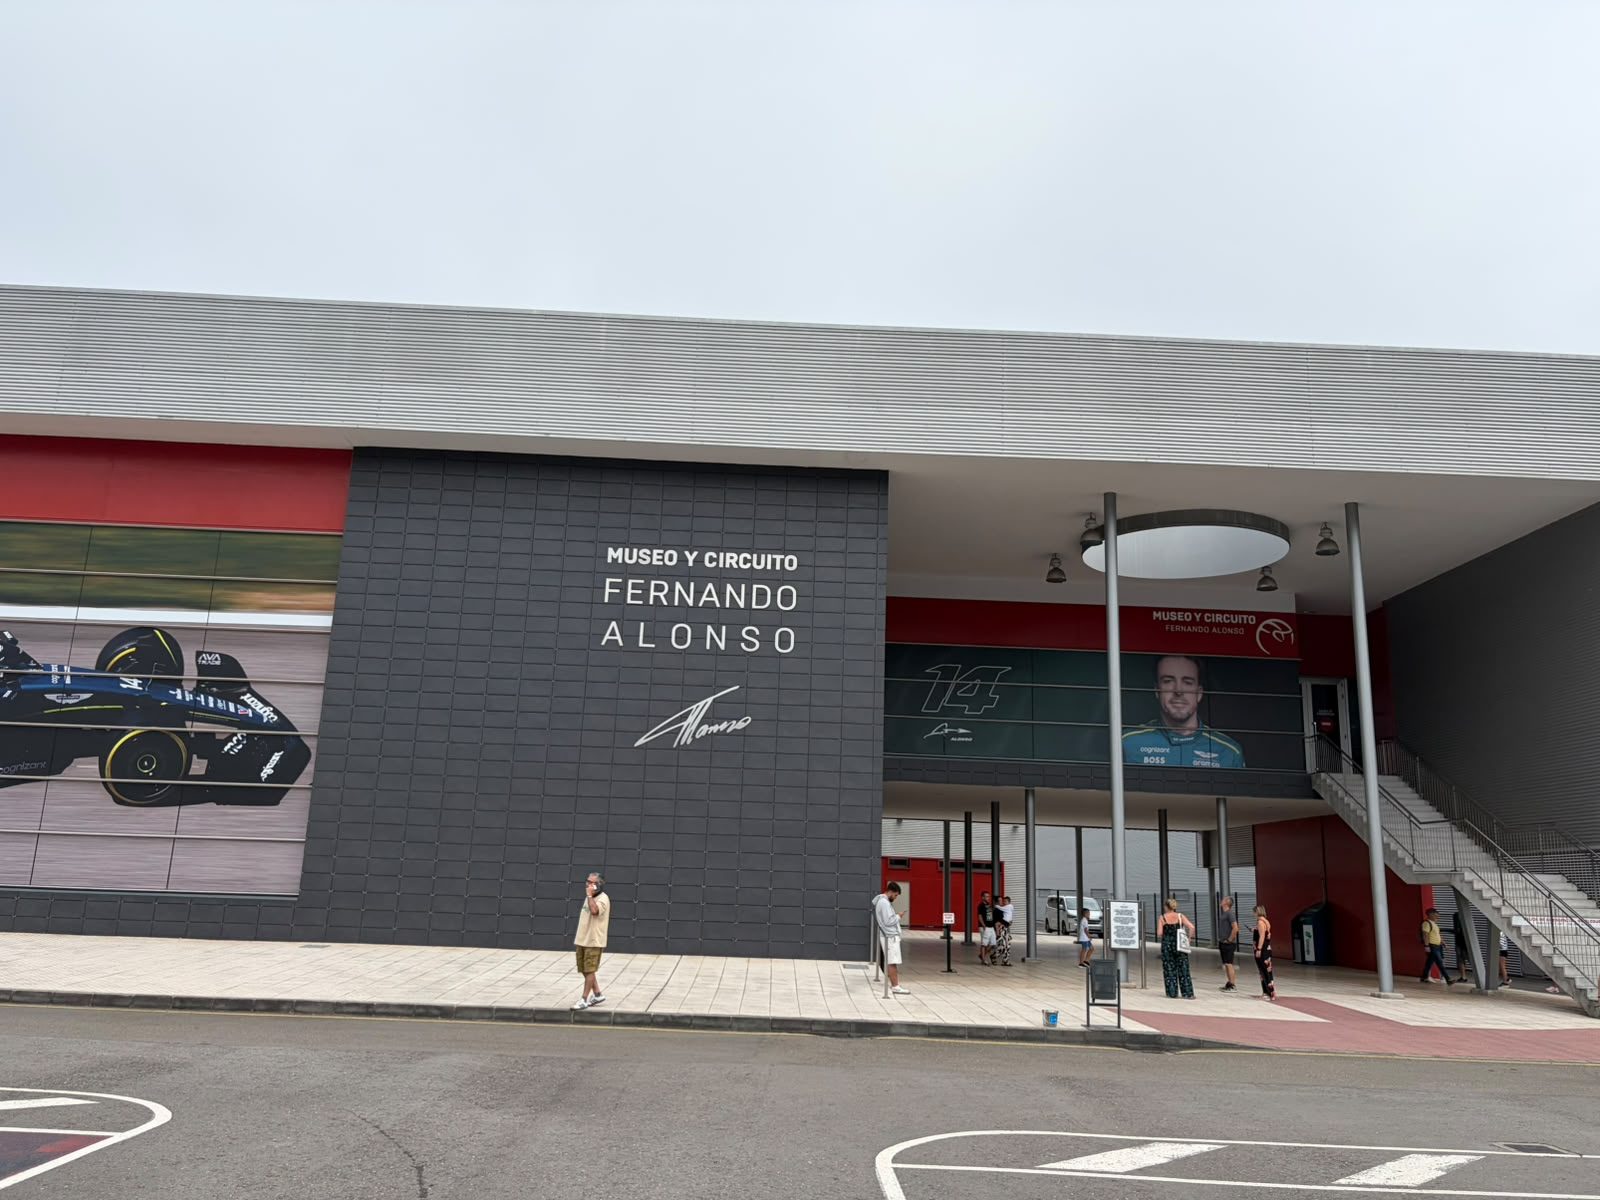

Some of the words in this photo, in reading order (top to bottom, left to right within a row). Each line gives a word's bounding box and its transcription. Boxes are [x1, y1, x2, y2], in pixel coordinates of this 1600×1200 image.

[607, 547, 678, 566] MUSEO
[684, 551, 698, 567] Y
[704, 551, 798, 571] CIRCUITO
[604, 577, 797, 611] FERNANDO
[1152, 610, 1192, 621] MUSEO
[1194, 612, 1202, 622] Y
[1204, 612, 1256, 625] CIRCUITO
[601, 620, 795, 653] ALONSO
[1165, 624, 1209, 634] FERNANDO
[1211, 626, 1245, 635] ALONSO
[198, 653, 222, 661] AVA
[921, 663, 1012, 715] 14
[1143, 756, 1166, 764] BOSS
